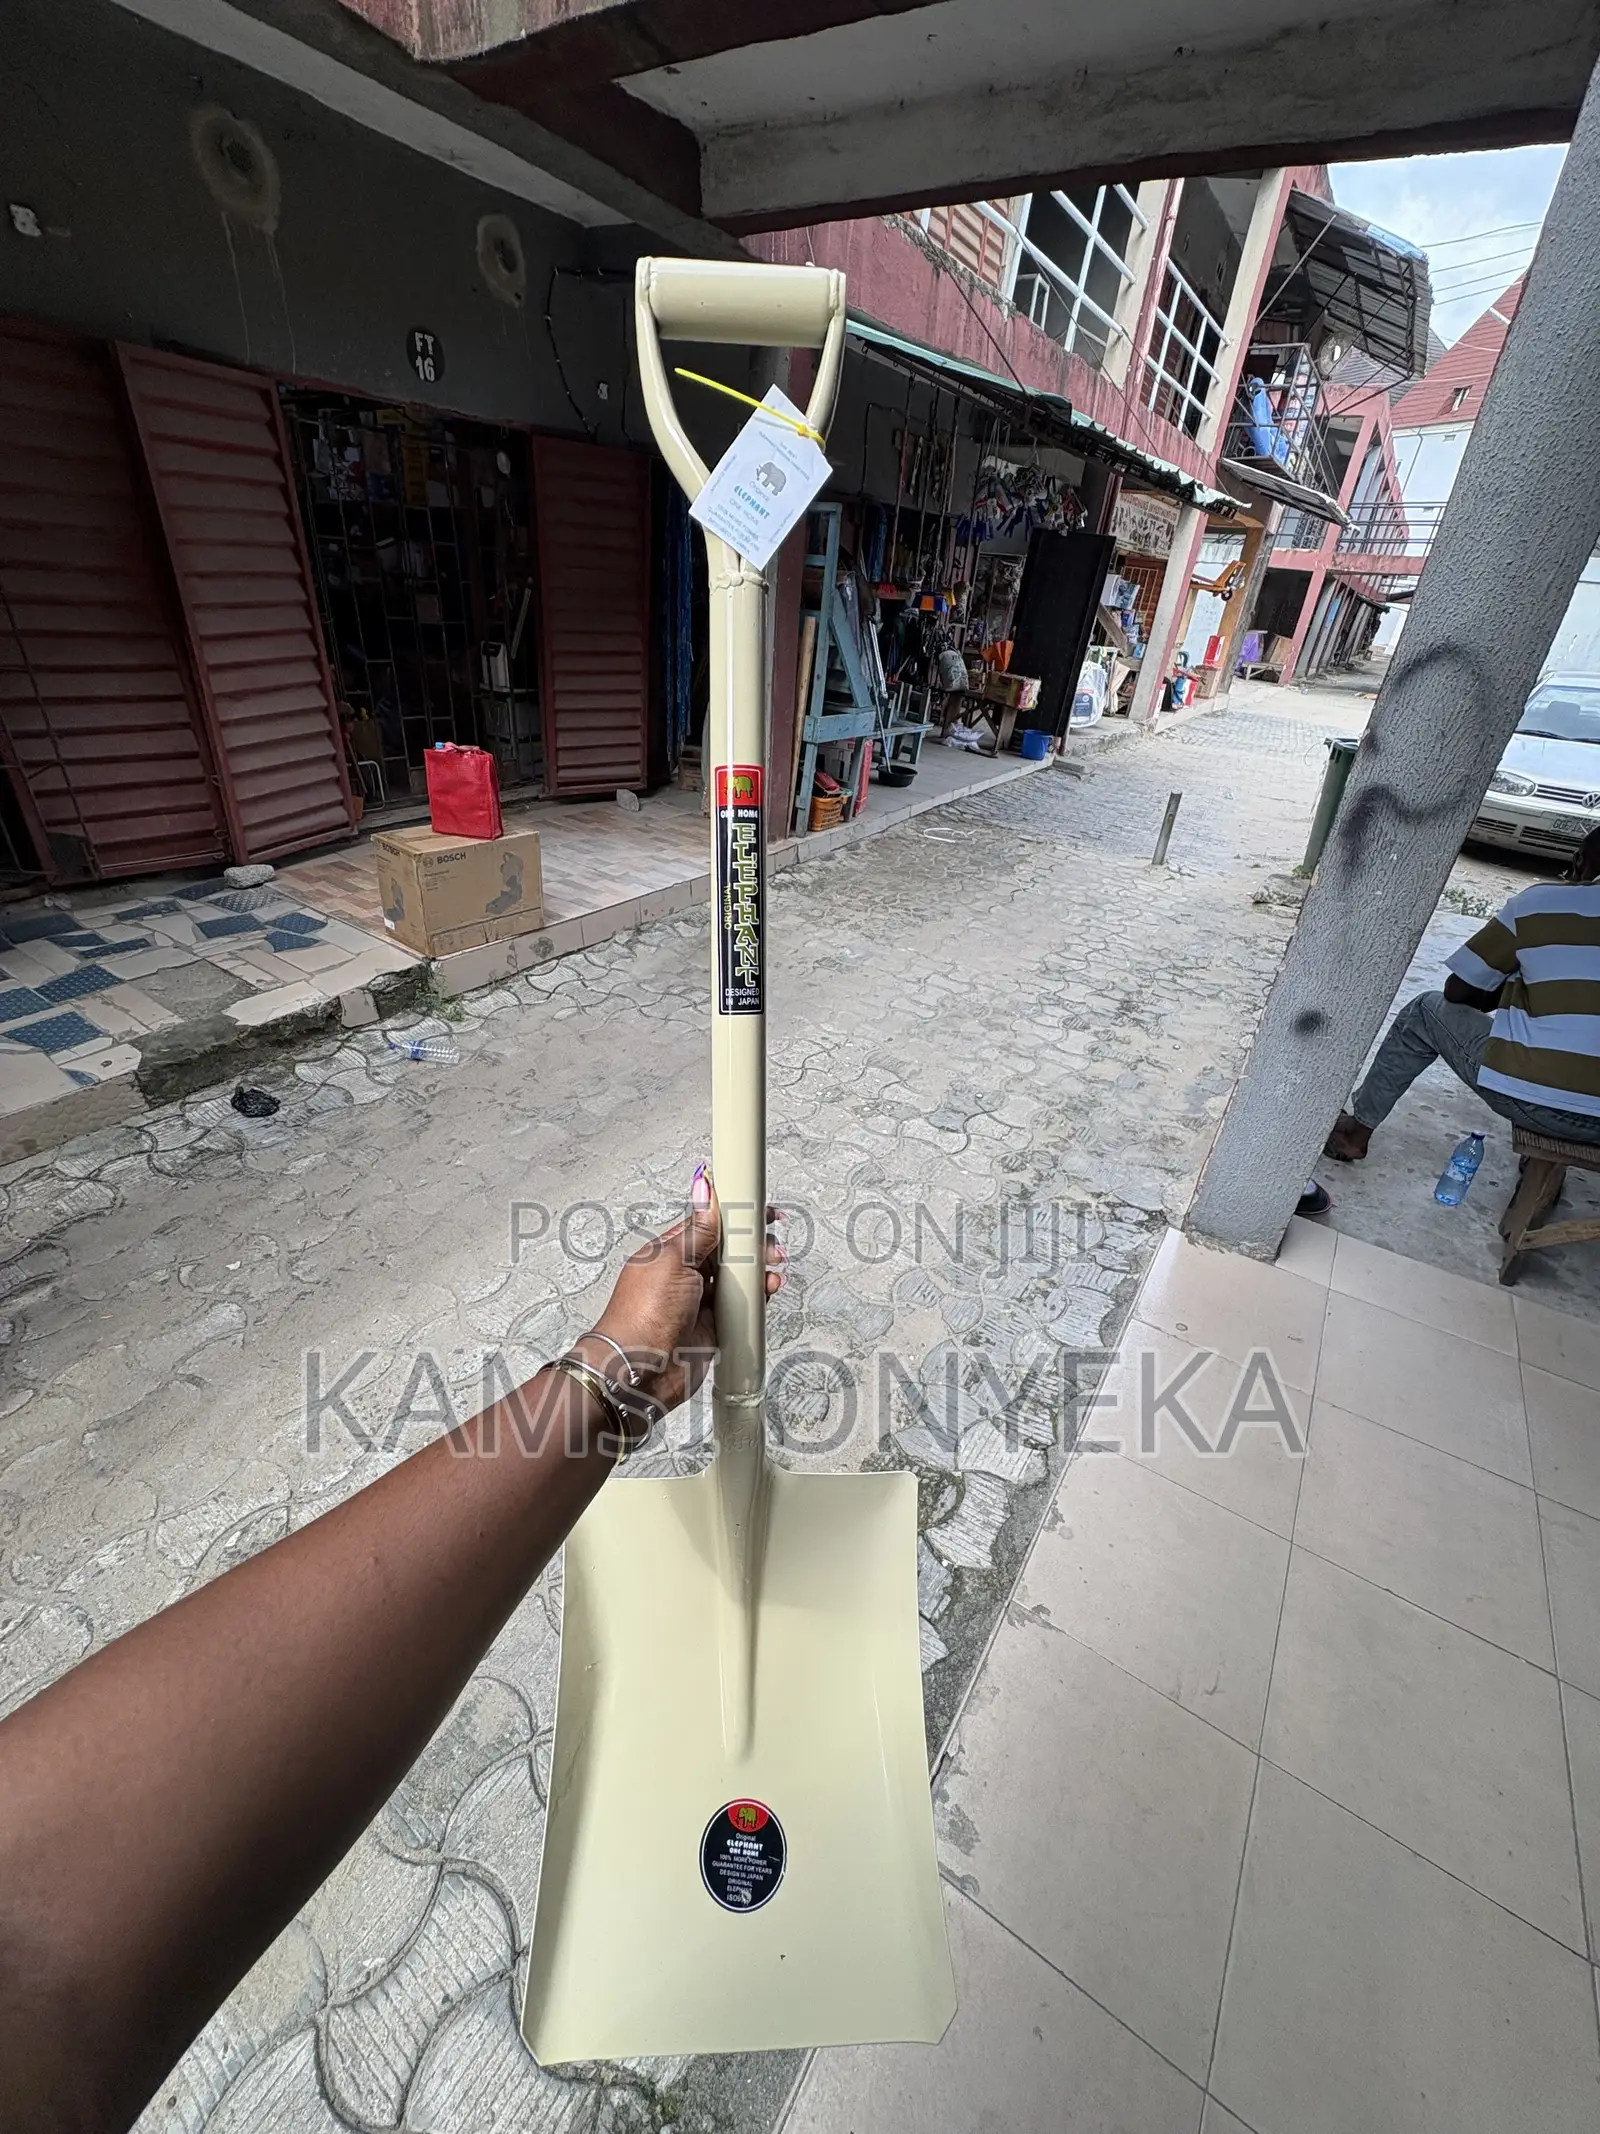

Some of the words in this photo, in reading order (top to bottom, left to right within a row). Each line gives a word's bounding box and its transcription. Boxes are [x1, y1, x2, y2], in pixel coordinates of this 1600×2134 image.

[415, 332, 434, 355] FT
[416, 356, 434, 381] 16
[733, 484, 770, 520] ELEPHANT
[738, 810, 758, 818] HOME
[437, 852, 466, 864] BOSCH
[724, 884, 732, 929] ORIGINAL
[732, 823, 760, 987] ELEPHANT
[725, 988, 760, 997] DESIGNED
[726, 997, 733, 1006] IN
[738, 997, 760, 1006] JAPAN
[736, 1833, 756, 1841] Original
[727, 1840, 763, 1850] ELEPHANT
[712, 1861, 743, 1870] GUARANTEE
[755, 1866, 772, 1874] YEARS
[719, 1869, 740, 1877] DESIGN
[747, 1873, 763, 1881] JAPAN
[728, 1878, 752, 1887] ORIGINAL
